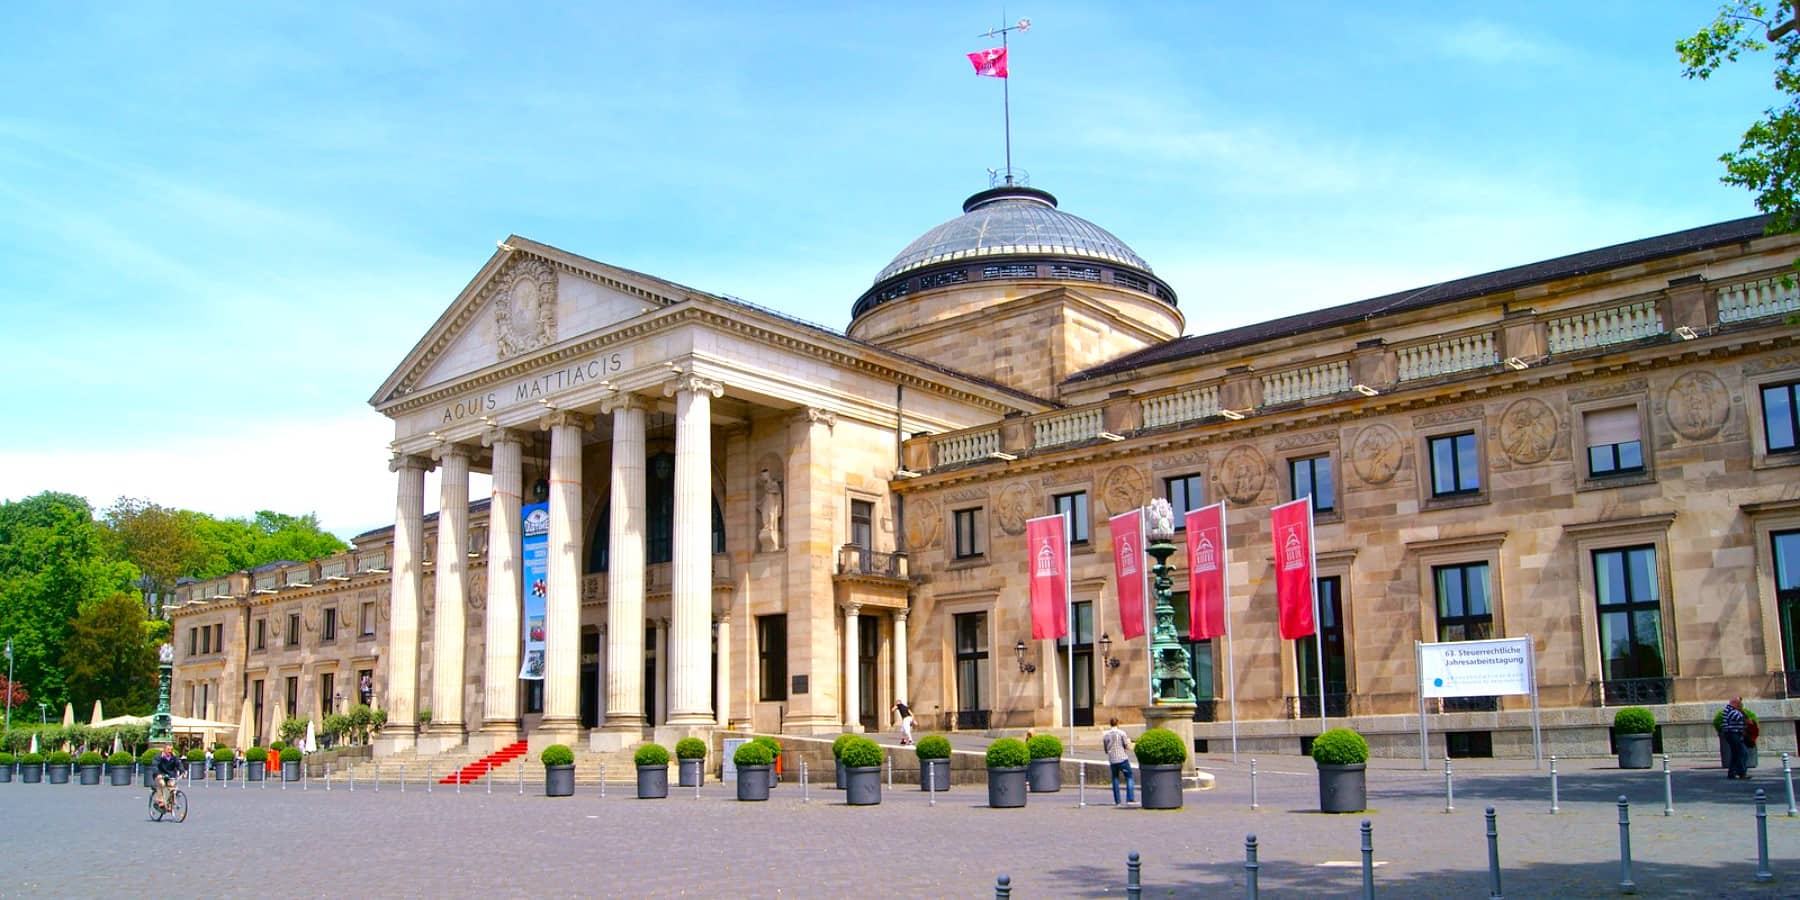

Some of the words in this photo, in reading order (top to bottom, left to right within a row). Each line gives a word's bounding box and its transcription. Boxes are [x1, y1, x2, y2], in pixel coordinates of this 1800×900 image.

[443, 393, 497, 424] AQUIS
[515, 353, 622, 401] MATTIACIS
[1458, 647, 1521, 656] Steuerrechtliche
[1445, 657, 1524, 666] Jahresarbeitstagung
